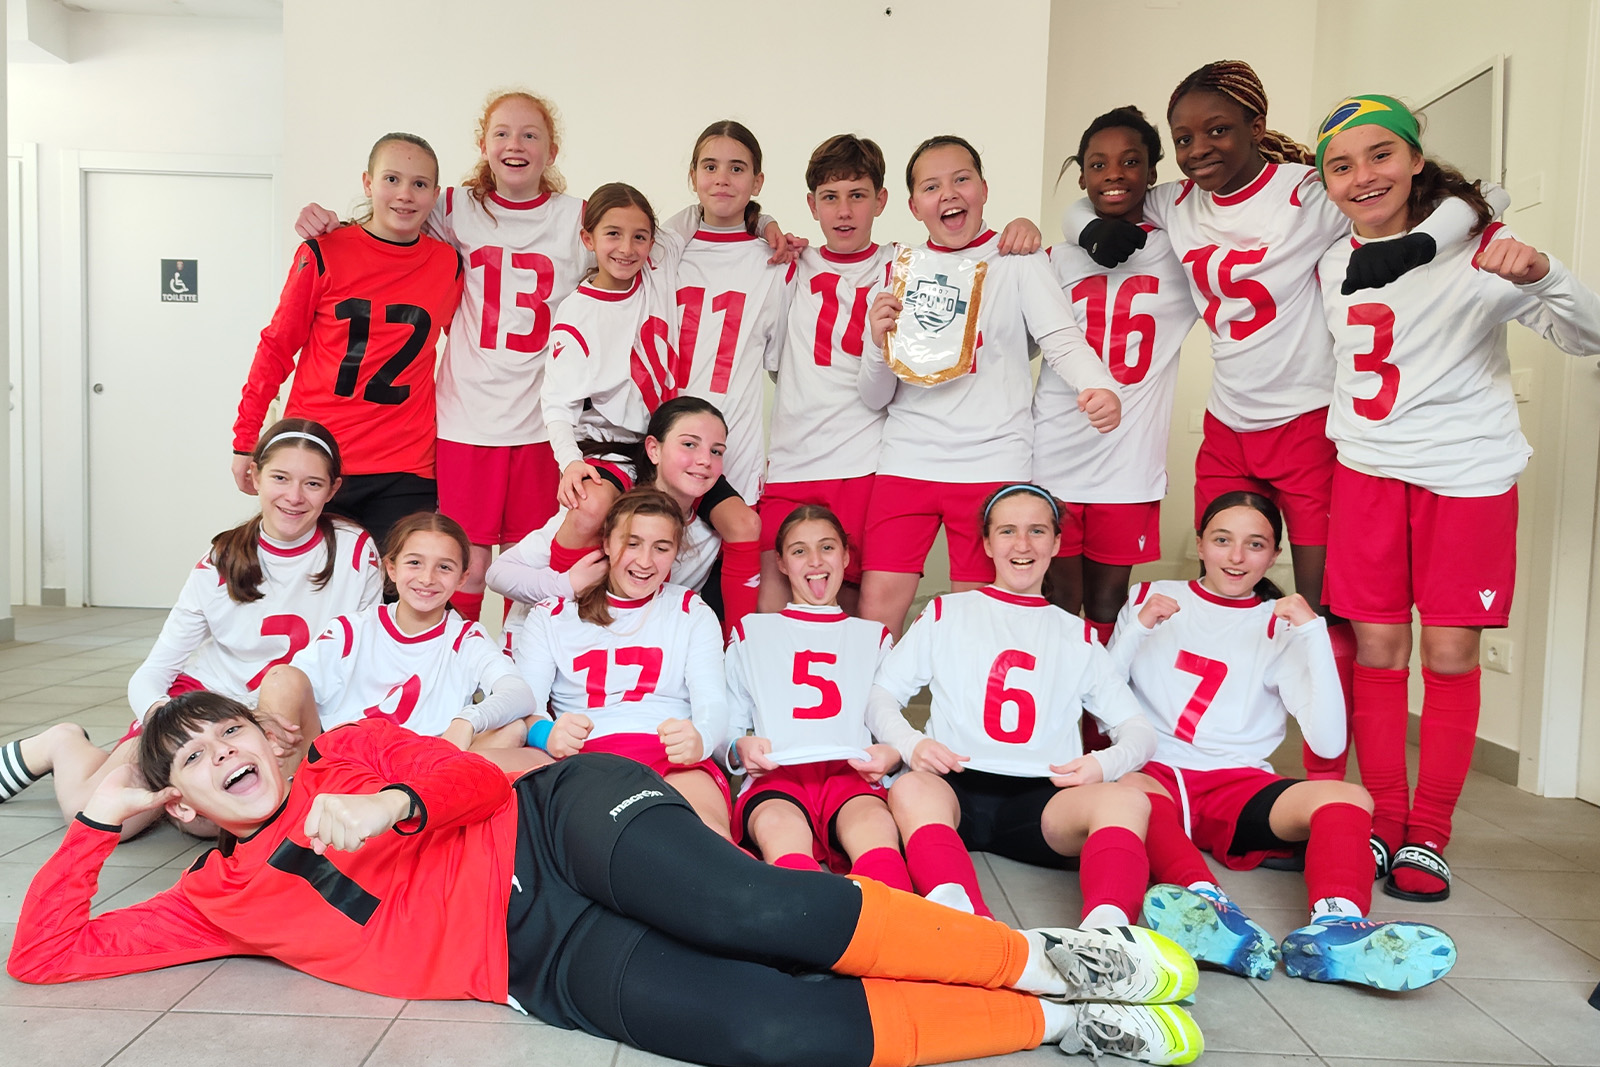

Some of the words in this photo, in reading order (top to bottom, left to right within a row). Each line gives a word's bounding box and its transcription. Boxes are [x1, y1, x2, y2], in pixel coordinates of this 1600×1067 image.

[162, 293, 197, 302] TOILETTE
[469, 245, 554, 353] 13
[676, 286, 746, 395] 11
[1071, 275, 1160, 385] 16
[1182, 245, 1277, 341] 15
[334, 298, 432, 405] 12
[1346, 303, 1401, 421] 3
[573, 646, 664, 708] 17
[792, 651, 843, 719] 5
[983, 649, 1037, 744] 6
[1174, 650, 1228, 744] 7
